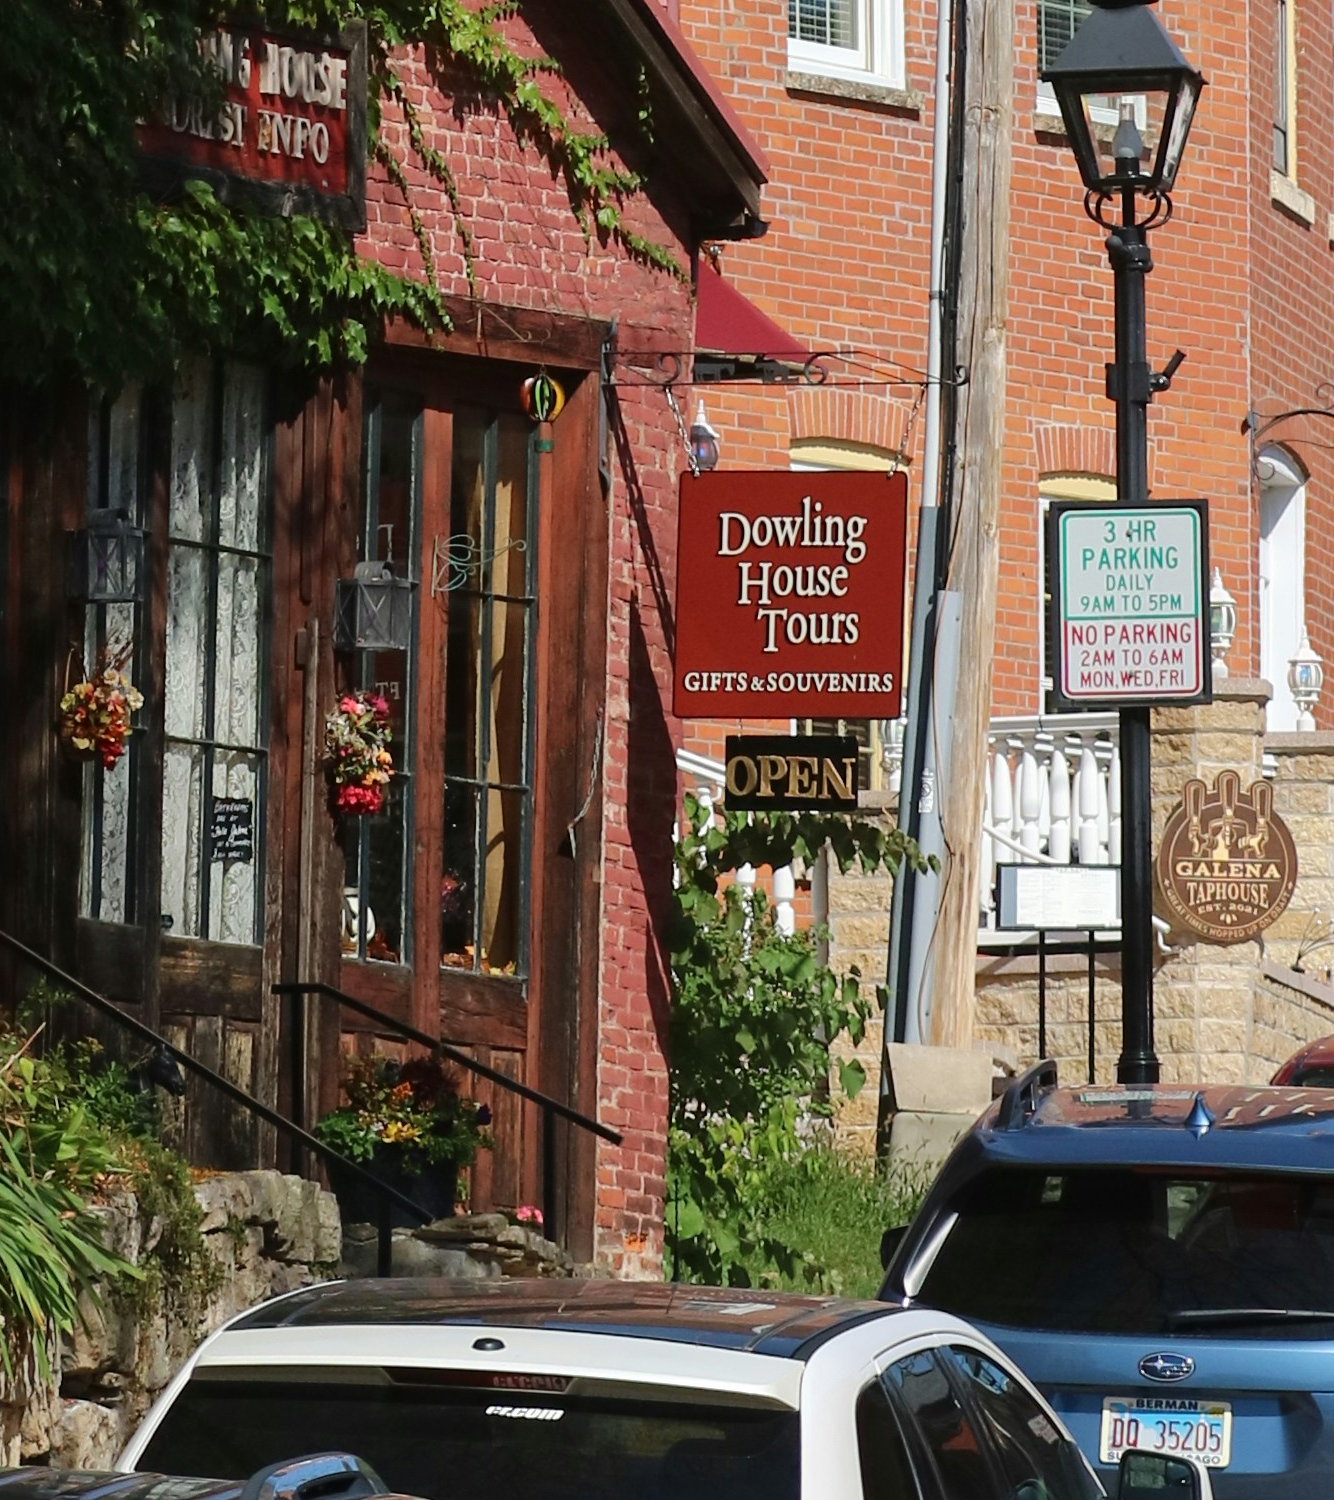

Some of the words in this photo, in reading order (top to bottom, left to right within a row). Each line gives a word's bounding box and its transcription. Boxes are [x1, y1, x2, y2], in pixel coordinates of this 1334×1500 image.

[258, 41, 347, 110] HOUSE
[256, 108, 329, 164] INFO
[717, 496, 868, 564] Dowling
[1103, 520, 1116, 543] 3
[1128, 520, 1157, 543] HR
[1082, 546, 1178, 571] PARKING
[737, 561, 849, 605] House
[1106, 574, 1154, 591] DAILY
[1080, 596, 1115, 612] 9AM
[1122, 595, 1142, 612] TO
[1149, 594, 1182, 611] 5PM
[757, 608, 859, 652] Tours
[1071, 625, 1098, 646] NO
[1104, 622, 1192, 645] PARKING
[1080, 650, 1115, 667] 2AM
[1122, 650, 1142, 666] TO
[1149, 649, 1184, 666] 6AM
[684, 671, 748, 692] GIFTS
[750, 677, 765, 692] &
[766, 672, 894, 693] SOUVENIRS
[725, 755, 857, 800] OPEN
[1175, 861, 1282, 879] GALENA
[1186, 881, 1270, 910] TAPHOUSE
[1197, 903, 1227, 915] EST.
[1228, 902, 1259, 916] 2021
[1208, 927, 1246, 938] HOPPED
[1247, 924, 1259, 935] UP
[1258, 917, 1273, 928] ON
[1270, 890, 1291, 919] DRAFT
[1136, 1399, 1198, 1411] BERMAN
[1112, 1418, 1139, 1449] DQ
[1154, 1420, 1222, 1453] 35205
